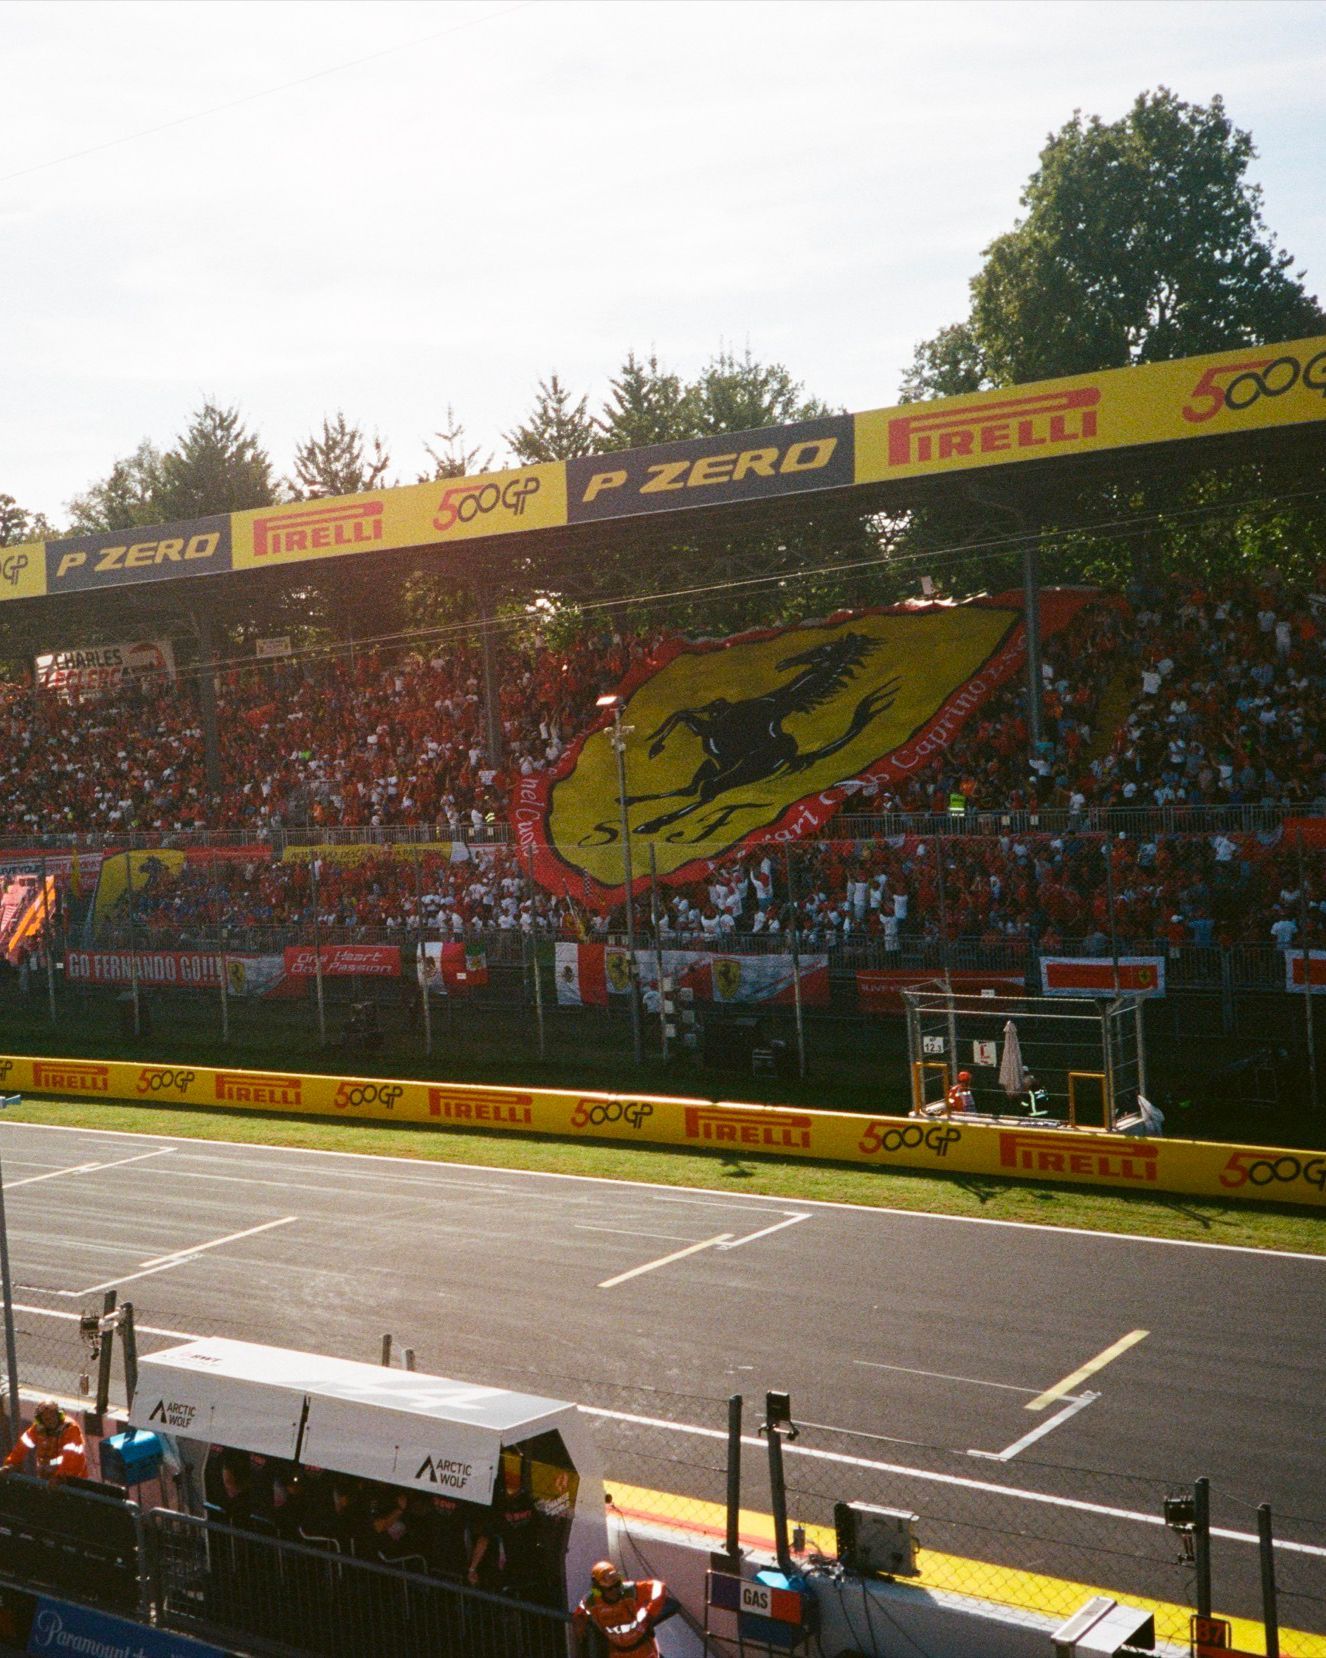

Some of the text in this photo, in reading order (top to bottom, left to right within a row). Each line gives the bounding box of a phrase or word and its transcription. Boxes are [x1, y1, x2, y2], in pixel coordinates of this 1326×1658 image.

[1182, 350, 1326, 423] 500G
[888, 386, 1101, 467] PIRELLI
[582, 437, 838, 502] P ZERO
[253, 501, 384, 556] PIRELLI
[0, 553, 29, 586] GP
[56, 532, 221, 577] P ZERO
[69, 953, 90, 977] GO
[94, 955, 177, 980] FERNANDO
[334, 950, 383, 963] Heart
[33, 1062, 108, 1091] PIRELLI
[215, 1073, 302, 1105] PIRELLI
[428, 1087, 533, 1125] PIRELLI
[685, 1107, 813, 1150] PIRELLI
[1000, 1132, 1159, 1182] PIRELLI
[1219, 1151, 1326, 1192] 500G
[166, 1402, 196, 1418] ARCTIC
[168, 1415, 193, 1429] WOLF
[436, 1458, 473, 1476] ARCTIC
[439, 1472, 468, 1489] WOLF
[742, 1589, 769, 1610] GAS
